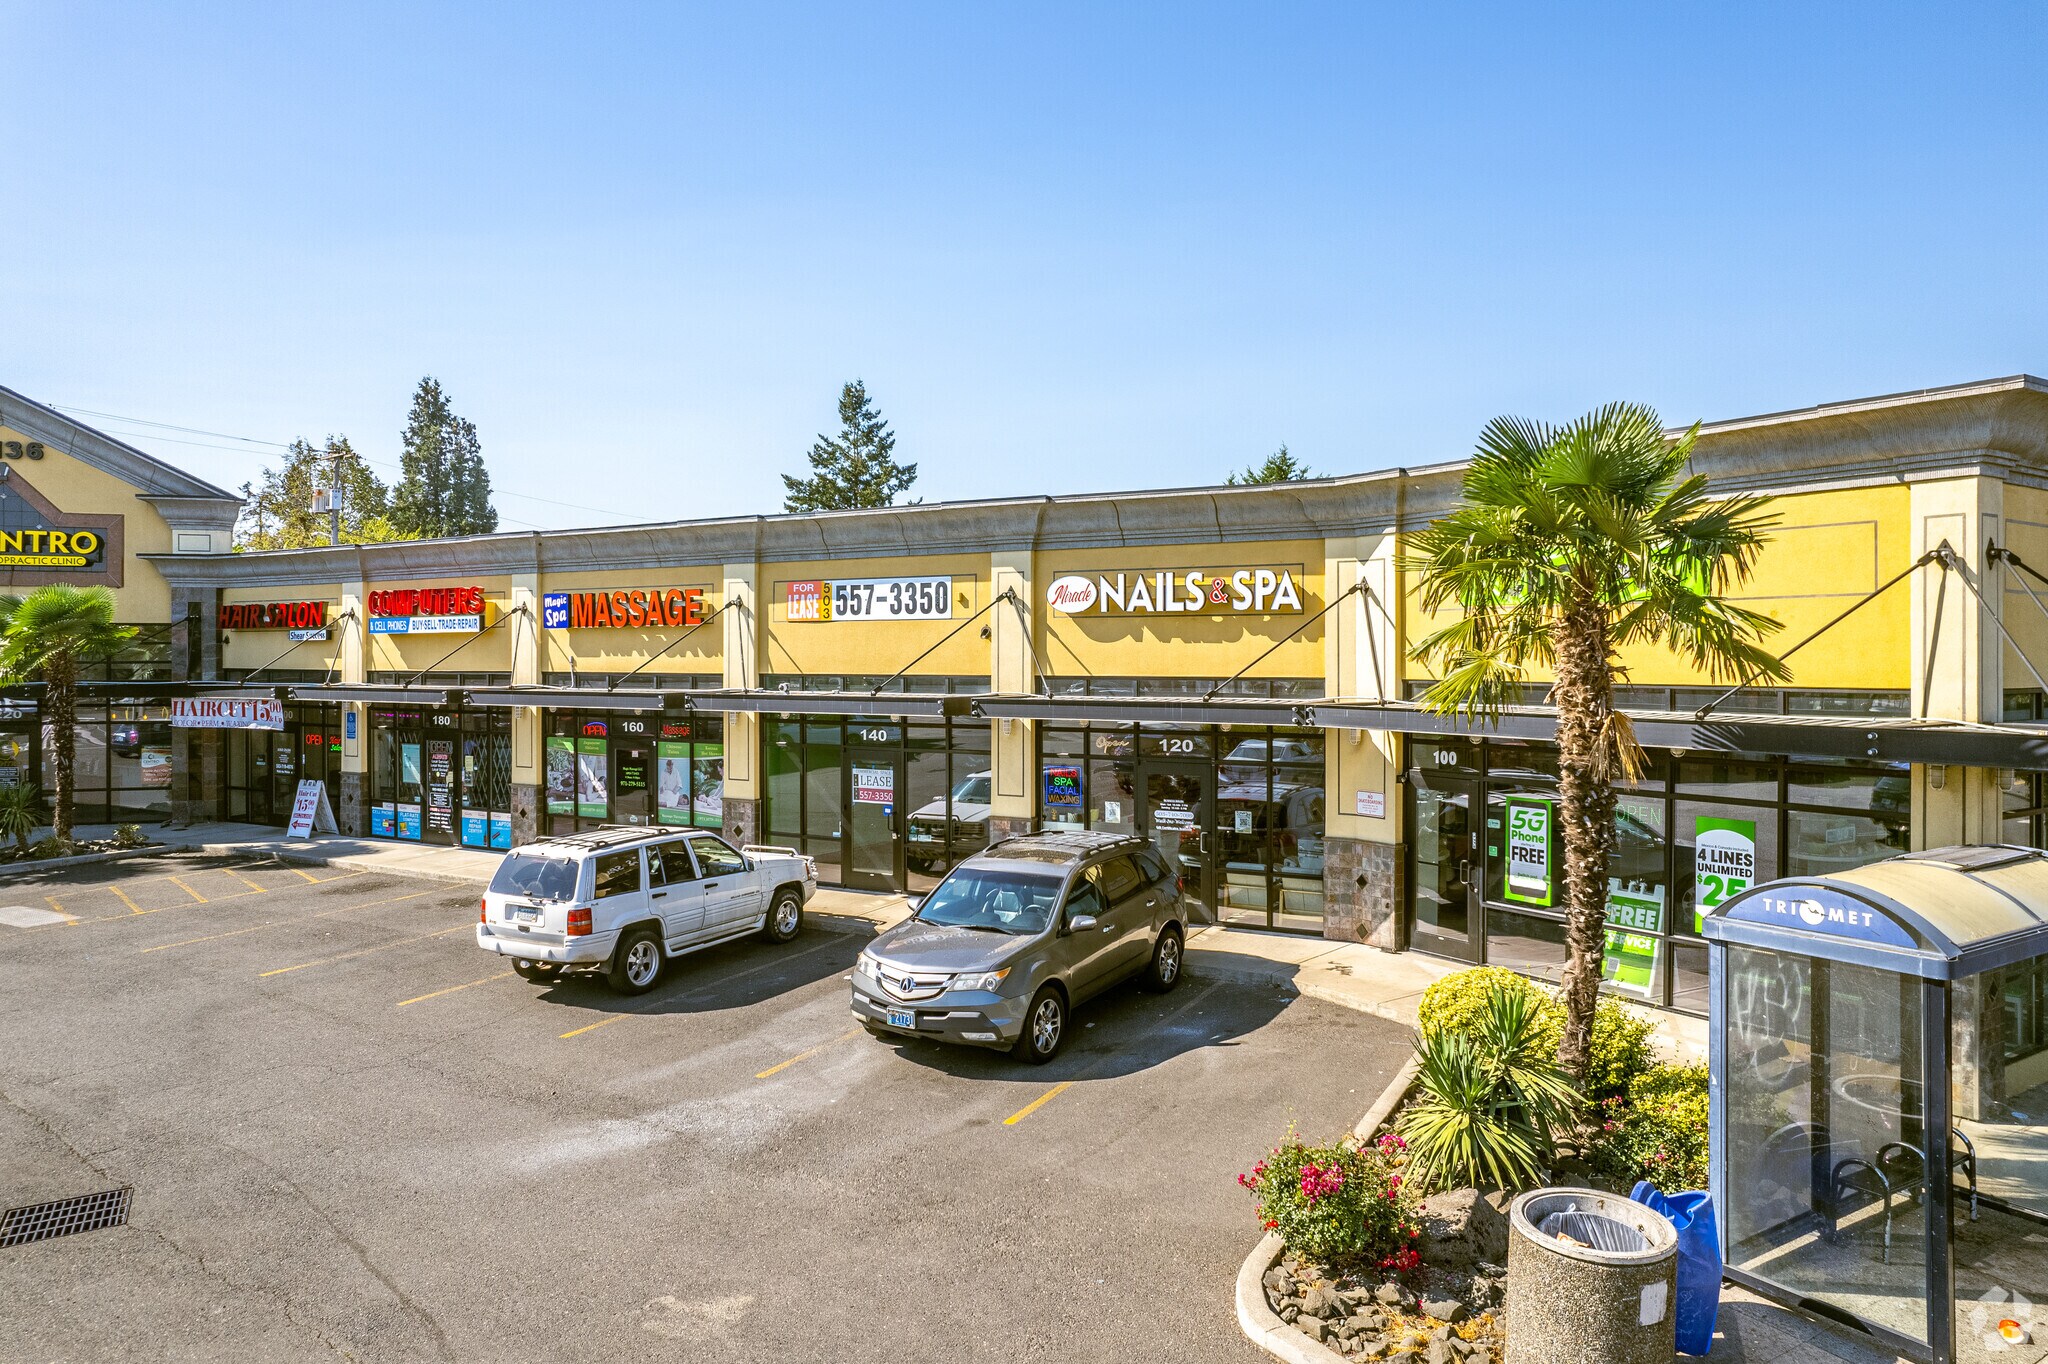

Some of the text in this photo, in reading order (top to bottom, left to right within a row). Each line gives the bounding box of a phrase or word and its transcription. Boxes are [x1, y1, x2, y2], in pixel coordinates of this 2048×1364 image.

[50, 557, 83, 565] CLINIC
[793, 583, 814, 593] FOR
[1051, 582, 1092, 605] Miracle
[1100, 569, 1302, 613] NAILS & SPA
[368, 585, 486, 617] COMPUTERS
[544, 595, 567, 608] Magic
[835, 581, 948, 616] 557-3350
[572, 588, 702, 629] MASSAGE
[787, 594, 820, 619] LEASE
[218, 601, 324, 630] HAIR SALON
[545, 608, 567, 627] Spa
[374, 621, 387, 631] CELL
[387, 621, 407, 631] PHONES
[412, 618, 478, 631] BUY SELL TRADE REPAIR
[291, 632, 305, 640] Shear
[0, 710, 22, 719] 20
[173, 700, 248, 718] HAIRCUT
[432, 716, 450, 726] 180
[622, 722, 644, 733] 160
[662, 724, 690, 737] Massage
[860, 729, 887, 742] 140
[1095, 735, 1130, 754] Open
[1159, 739, 1194, 753] 120
[1433, 751, 1457, 766] 100
[1050, 768, 1078, 778] NAILS
[860, 775, 892, 787] LEASE
[1054, 777, 1074, 786] SPA
[859, 790, 893, 801] 557-3350
[1048, 786, 1079, 796] FACIAL
[1048, 795, 1080, 804] WAXING
[1511, 810, 1545, 832] 5G
[1615, 802, 1662, 826] OPEN
[1511, 830, 1545, 844] Phone
[1511, 846, 1545, 866] FREE
[1697, 848, 1753, 867] 4 LINES
[1697, 863, 1753, 878] UNLIMITED
[1609, 903, 1657, 930] FREE
[1827, 908, 1873, 927] MET
[1607, 930, 1652, 950] SERVICE
